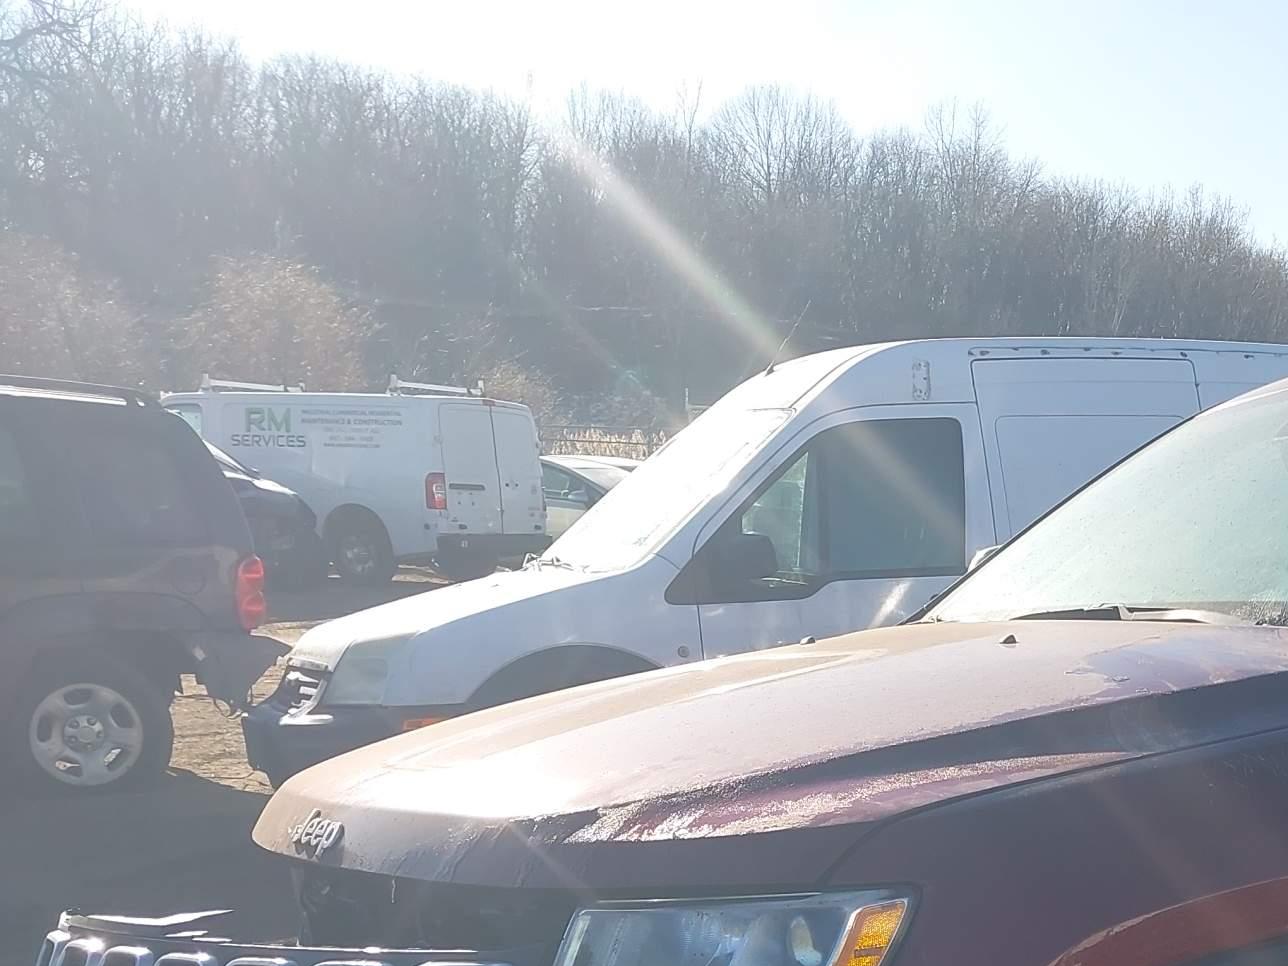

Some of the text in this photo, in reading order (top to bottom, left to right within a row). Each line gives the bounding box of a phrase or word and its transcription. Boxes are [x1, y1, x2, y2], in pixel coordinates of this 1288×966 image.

[245, 408, 291, 432] RM
[231, 434, 306, 448] SERVICES
[287, 808, 343, 857] Jeep
